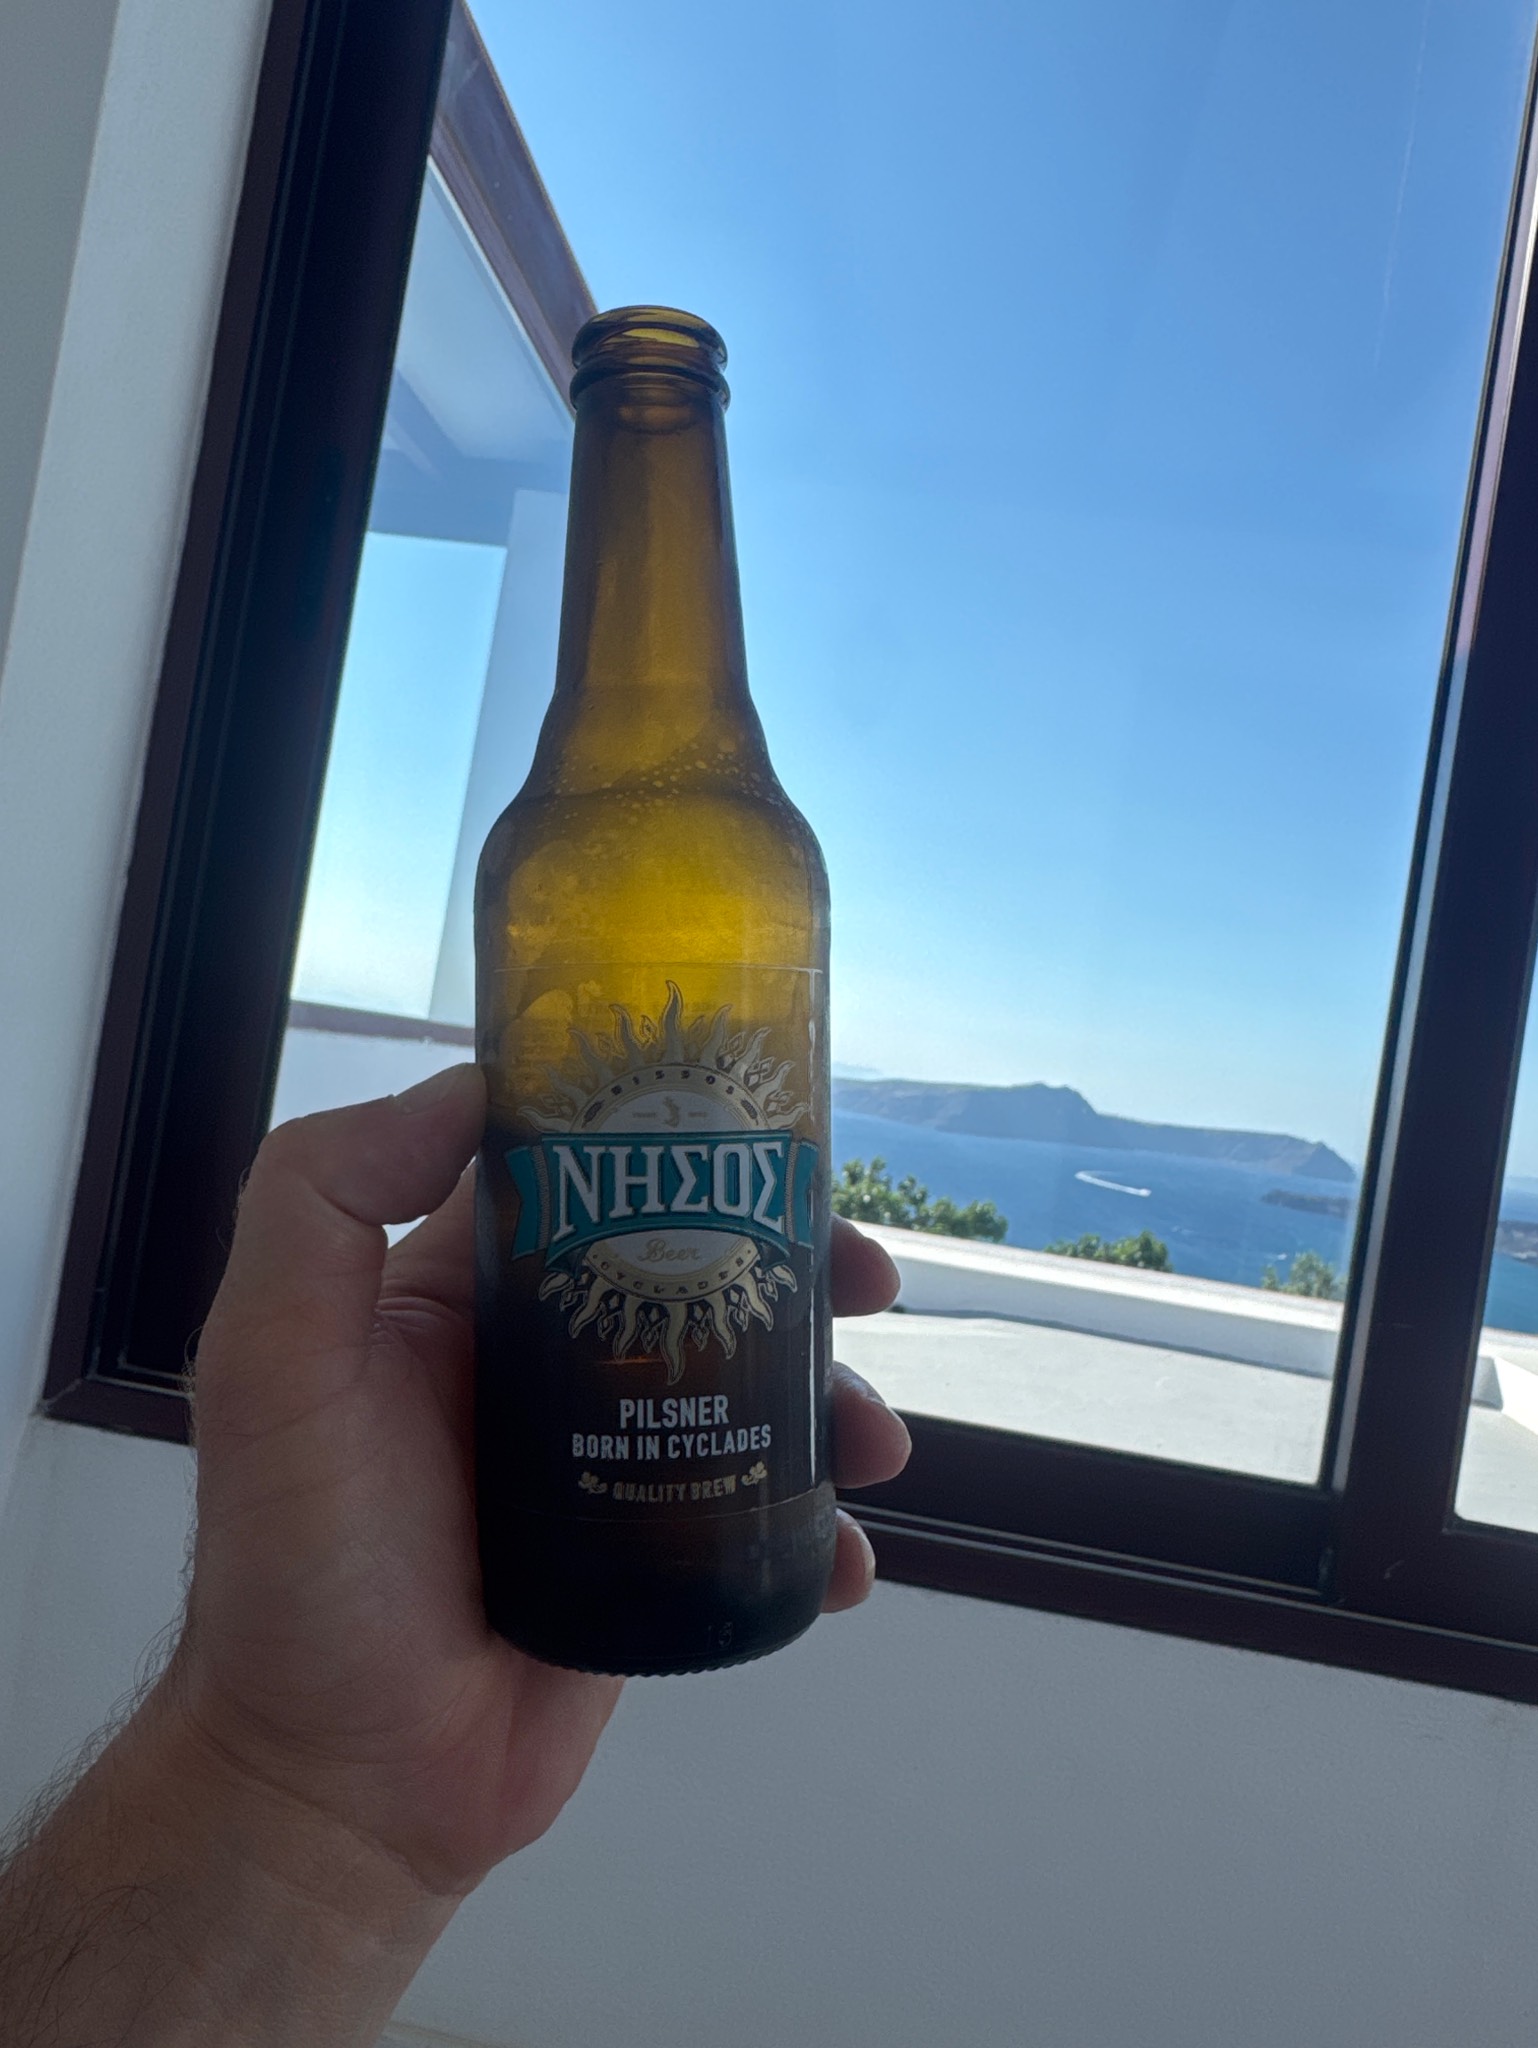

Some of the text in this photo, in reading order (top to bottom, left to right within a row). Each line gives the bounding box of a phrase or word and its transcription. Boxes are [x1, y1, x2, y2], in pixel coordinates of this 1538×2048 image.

[552, 1141, 785, 1243] ΝΗΣΟΣ
[637, 1238, 701, 1263] Beer
[600, 1257, 745, 1295] CYCLADES
[619, 1394, 730, 1430] PILSNER
[572, 1423, 772, 1461] BORN IN CYCLADES
[613, 1474, 737, 1503] QUALITY BREW
